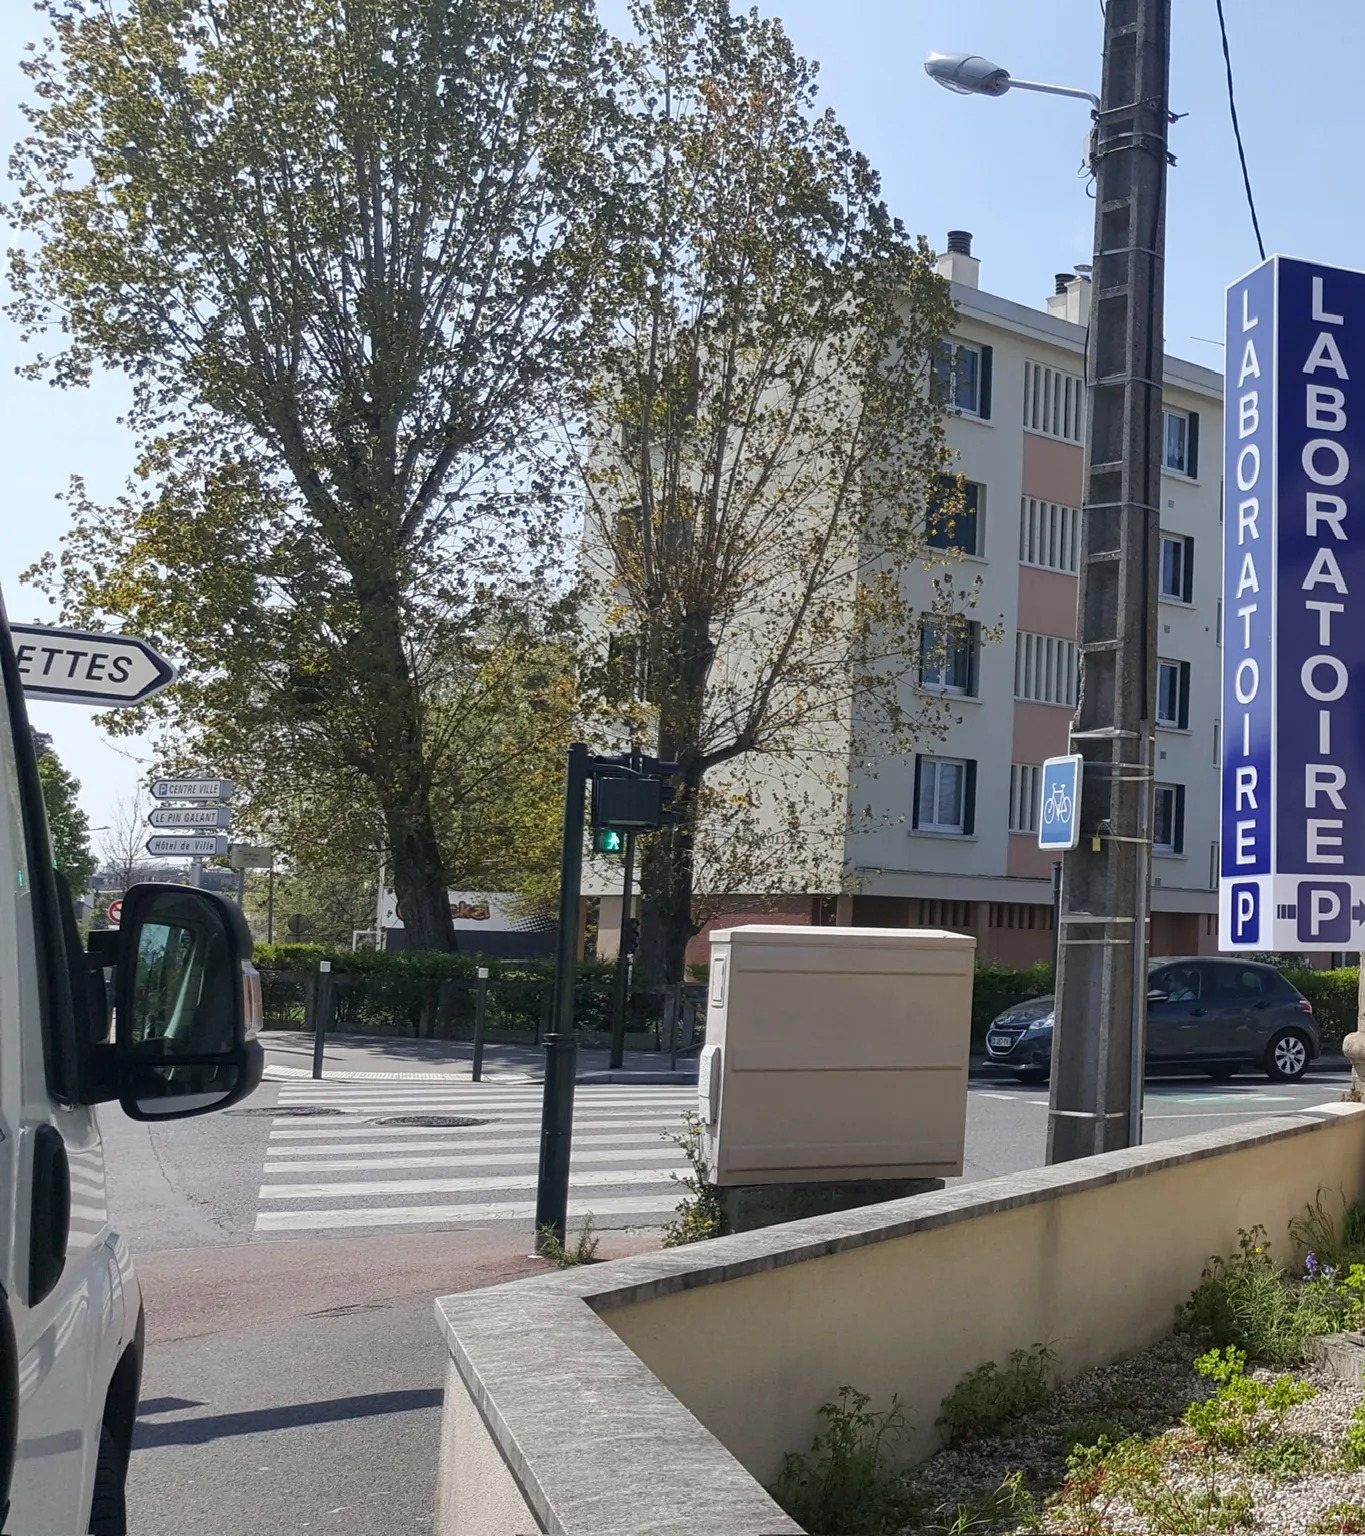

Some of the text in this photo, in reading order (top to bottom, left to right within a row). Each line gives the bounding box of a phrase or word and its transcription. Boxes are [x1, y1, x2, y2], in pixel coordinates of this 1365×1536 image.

[1234, 287, 1261, 866] LABORATOIRE
[1300, 275, 1350, 865] LABORATOIRE
[169, 784, 197, 794] CENTRE
[200, 784, 218, 794] VILLE
[155, 812, 216, 823] LE PIN GALANT
[155, 840, 214, 851] Hôtel de Ville
[1237, 890, 1254, 936] P
[1310, 889, 1341, 936] P
